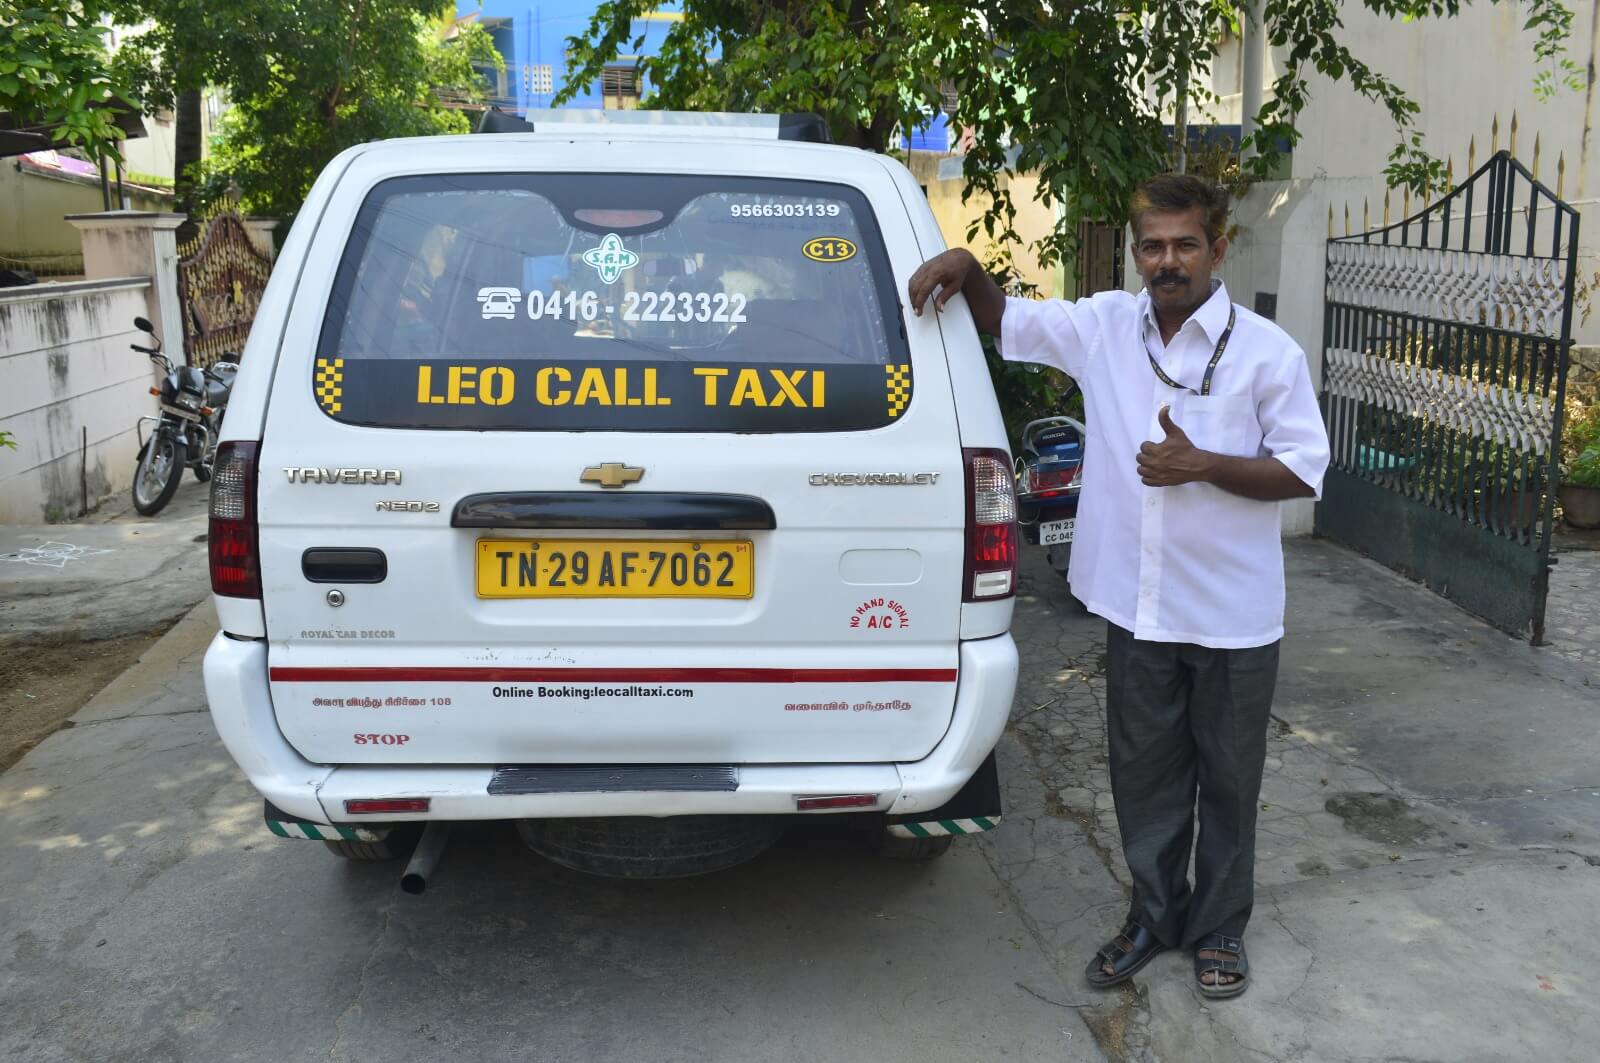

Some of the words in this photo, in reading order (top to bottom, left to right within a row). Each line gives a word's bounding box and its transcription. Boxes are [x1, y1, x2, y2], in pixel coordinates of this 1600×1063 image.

[730, 204, 840, 217] 9566303139
[809, 242, 849, 257] C13
[527, 290, 599, 321] 0416
[623, 291, 747, 323] 2223322
[417, 365, 516, 406] LEO
[535, 366, 672, 407] CALL
[693, 367, 826, 408] TAXI
[1042, 432, 1066, 440] HONDA
[283, 467, 402, 486] TAVERA
[809, 471, 941, 486] CHEVROLET
[1049, 523, 1062, 532] TN
[1045, 533, 1057, 542] CC
[849, 616, 860, 628] NO
[855, 598, 884, 615] HAND
[887, 600, 909, 629] SIGNAL
[867, 615, 893, 629] A/C
[301, 630, 335, 639] ROYAL
[337, 630, 357, 639] CAR
[360, 630, 395, 639] DECOR
[492, 686, 534, 698] Online
[430, 697, 452, 706] 108
[353, 733, 410, 745] STOP
